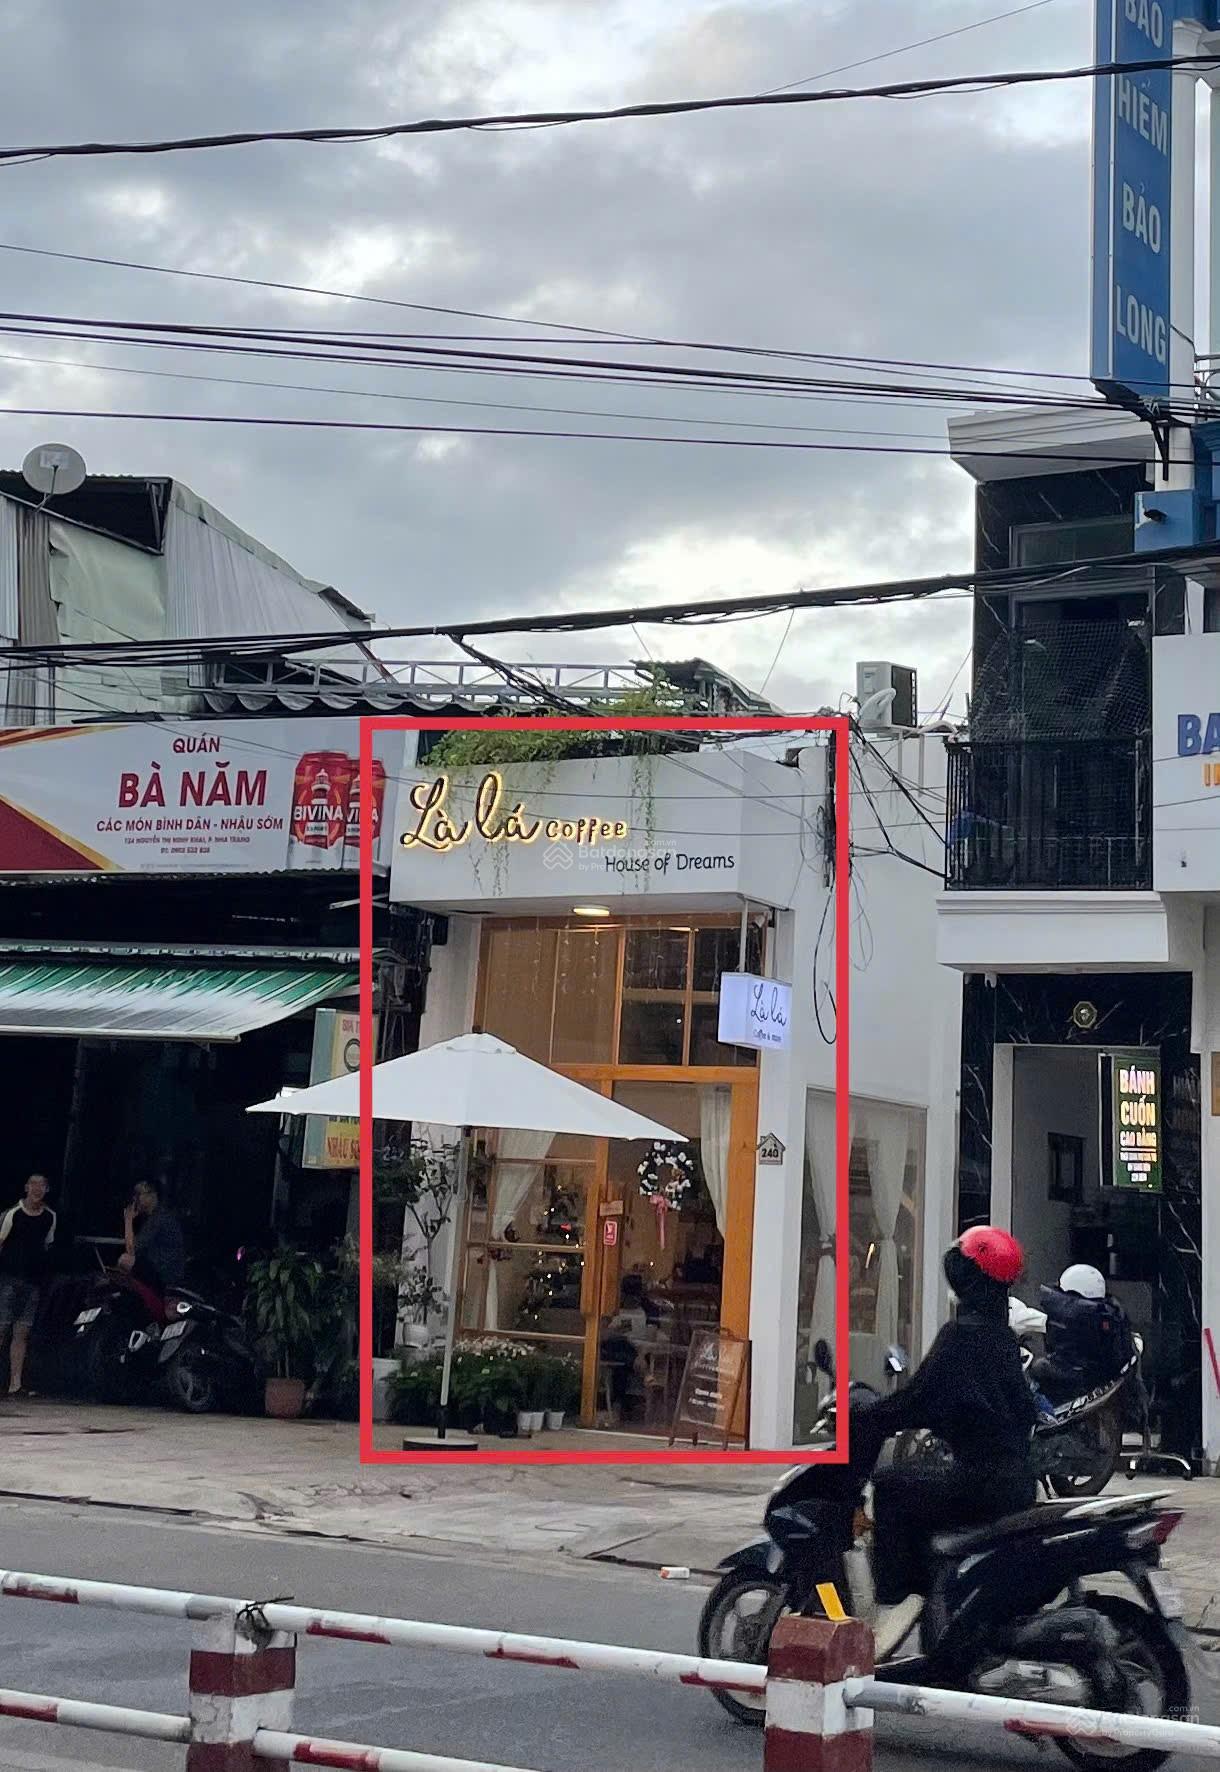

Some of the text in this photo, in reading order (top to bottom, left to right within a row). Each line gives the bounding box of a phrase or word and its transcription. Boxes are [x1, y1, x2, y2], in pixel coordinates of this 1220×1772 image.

[1118, 77, 1168, 156] HIỂM
[1122, 183, 1161, 254] BẢO
[1114, 285, 1168, 366] LONG
[172, 732, 221, 754] QUÁN
[119, 761, 267, 808] BÀ NĂM
[96, 818, 122, 832] CÁC
[125, 816, 152, 832] MÓN
[156, 817, 182, 831] BÌNH
[186, 816, 210, 831] DÂN
[221, 815, 253, 834] NHẬU
[256, 815, 283, 831] SỚM
[294, 805, 343, 821] BIVINA
[347, 808, 379, 822] VIA
[545, 817, 629, 846] coffee
[605, 855, 649, 873] House
[654, 852, 671, 875] of
[676, 853, 735, 871] Dreams
[1119, 1065, 1156, 1095] BÁNH
[1120, 1095, 1156, 1127] CUỐN
